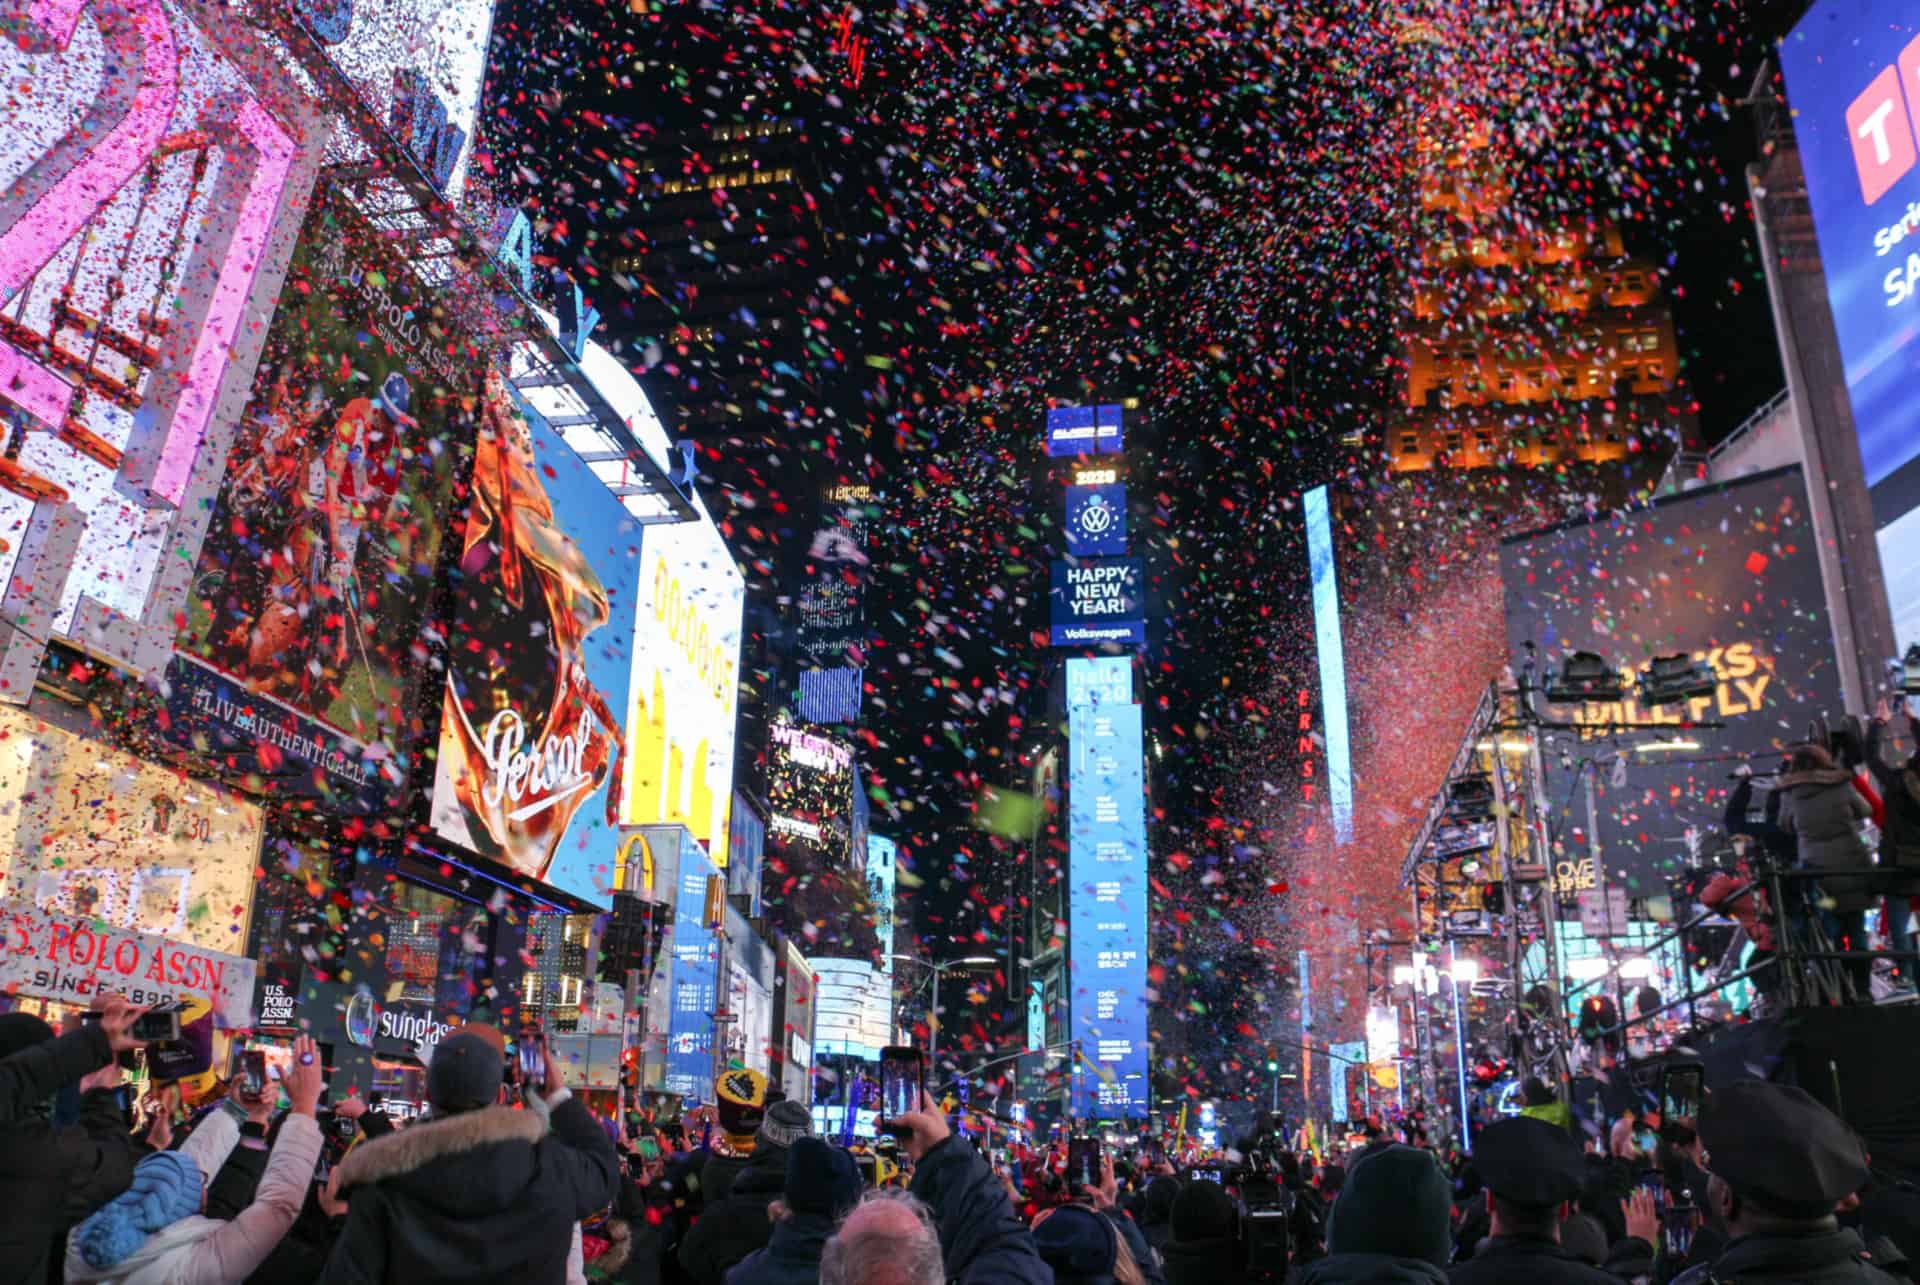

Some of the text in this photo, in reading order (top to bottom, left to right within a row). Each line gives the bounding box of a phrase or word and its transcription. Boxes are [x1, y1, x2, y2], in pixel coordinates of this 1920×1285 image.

[1067, 565, 1129, 584] HAPPY
[1075, 582, 1121, 599] NEW
[1070, 598, 1126, 615] YEAR!
[1065, 628, 1132, 641] Volkswagen
[1297, 690, 1314, 801] ERNST
[481, 708, 593, 822] Persol
[46, 923, 140, 976] POLO
[144, 945, 228, 995] ASSN.
[264, 984, 285, 996] U.S.
[381, 1009, 456, 1053] sunglas
